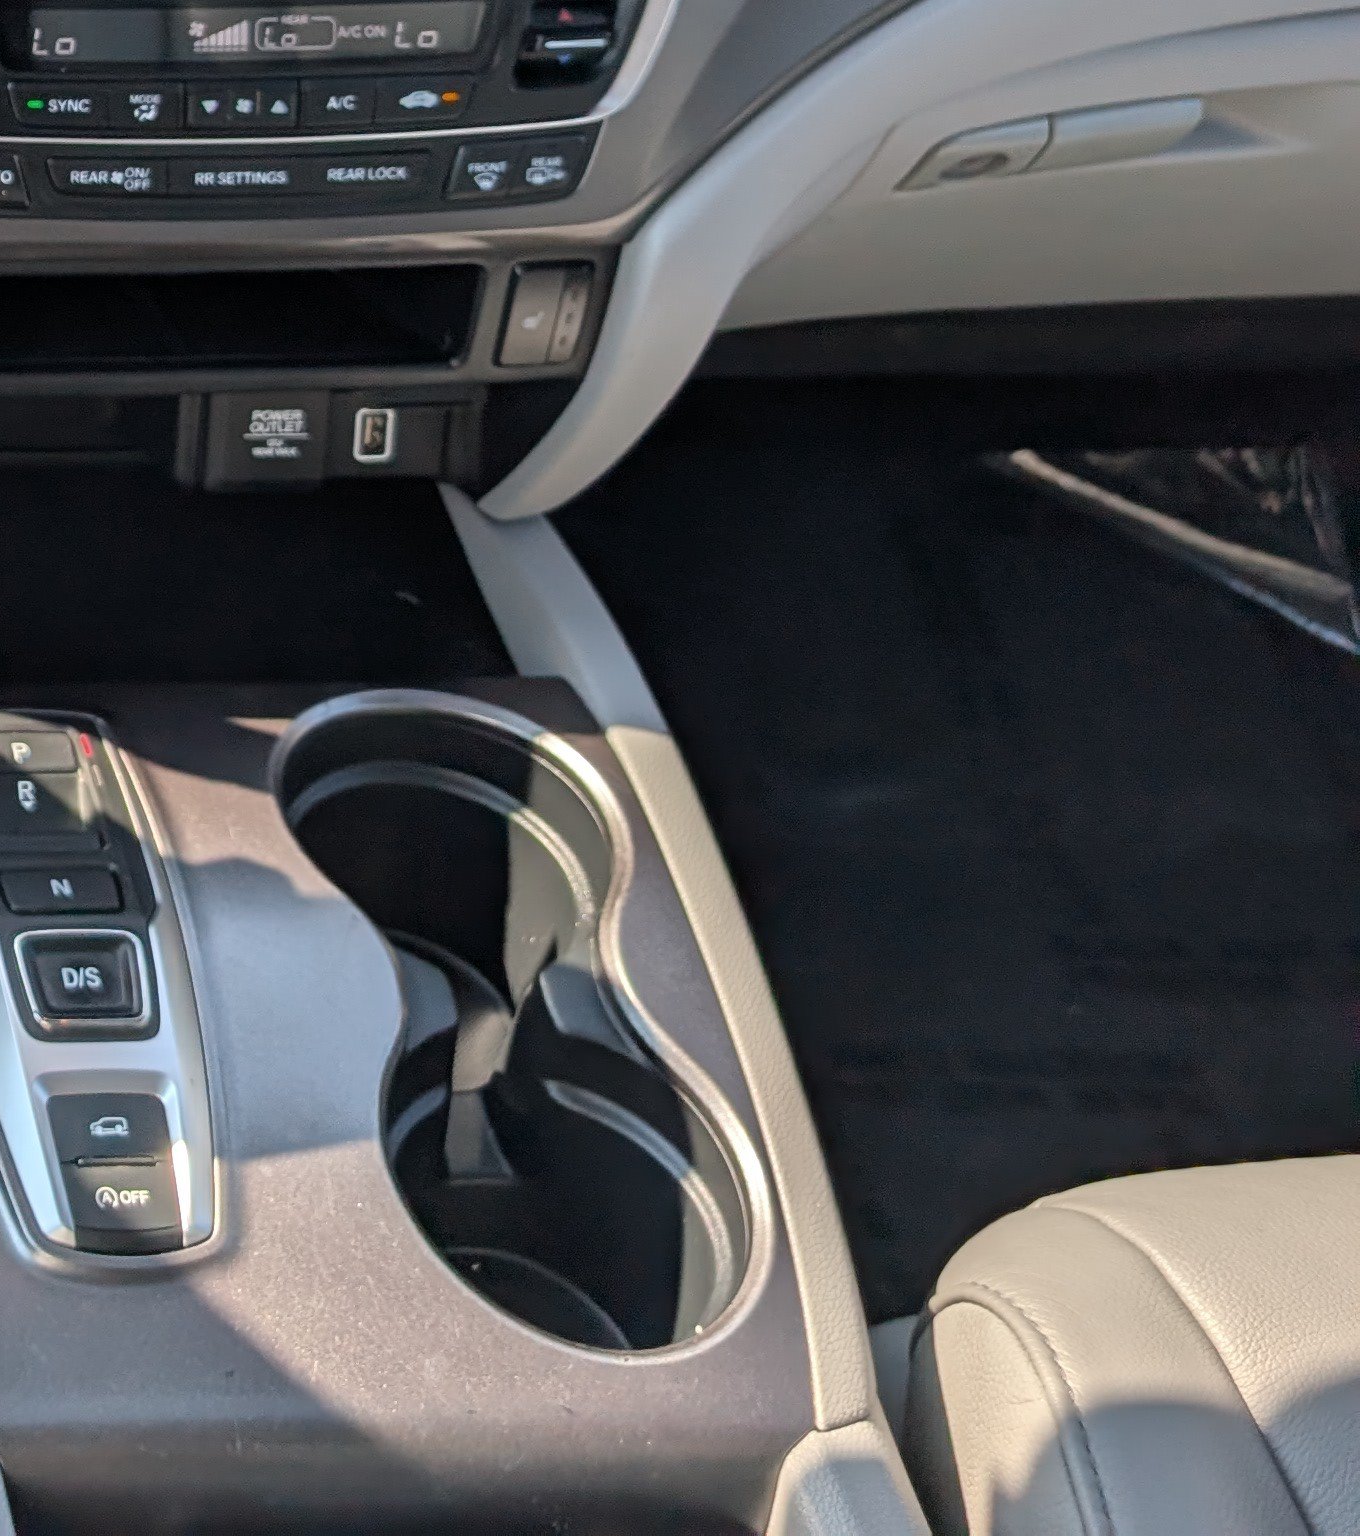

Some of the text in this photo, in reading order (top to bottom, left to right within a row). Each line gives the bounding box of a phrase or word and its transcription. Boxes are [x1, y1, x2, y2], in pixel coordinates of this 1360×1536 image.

[48, 98, 92, 113] SYNC
[129, 94, 161, 104] MODE
[326, 94, 358, 111] A/C
[326, 166, 408, 182] REAR LOCK
[467, 161, 507, 174] FRONT
[69, 170, 109, 184] REAR
[194, 170, 289, 185] RR SETTINGS
[123, 178, 150, 192] OFF
[251, 409, 304, 421] POWER
[249, 420, 304, 433] OUTLET
[11, 741, 32, 764] P
[17, 779, 36, 801] R
[51, 878, 74, 898] N
[61, 965, 104, 992] D/S
[119, 1189, 150, 1206] OFF
